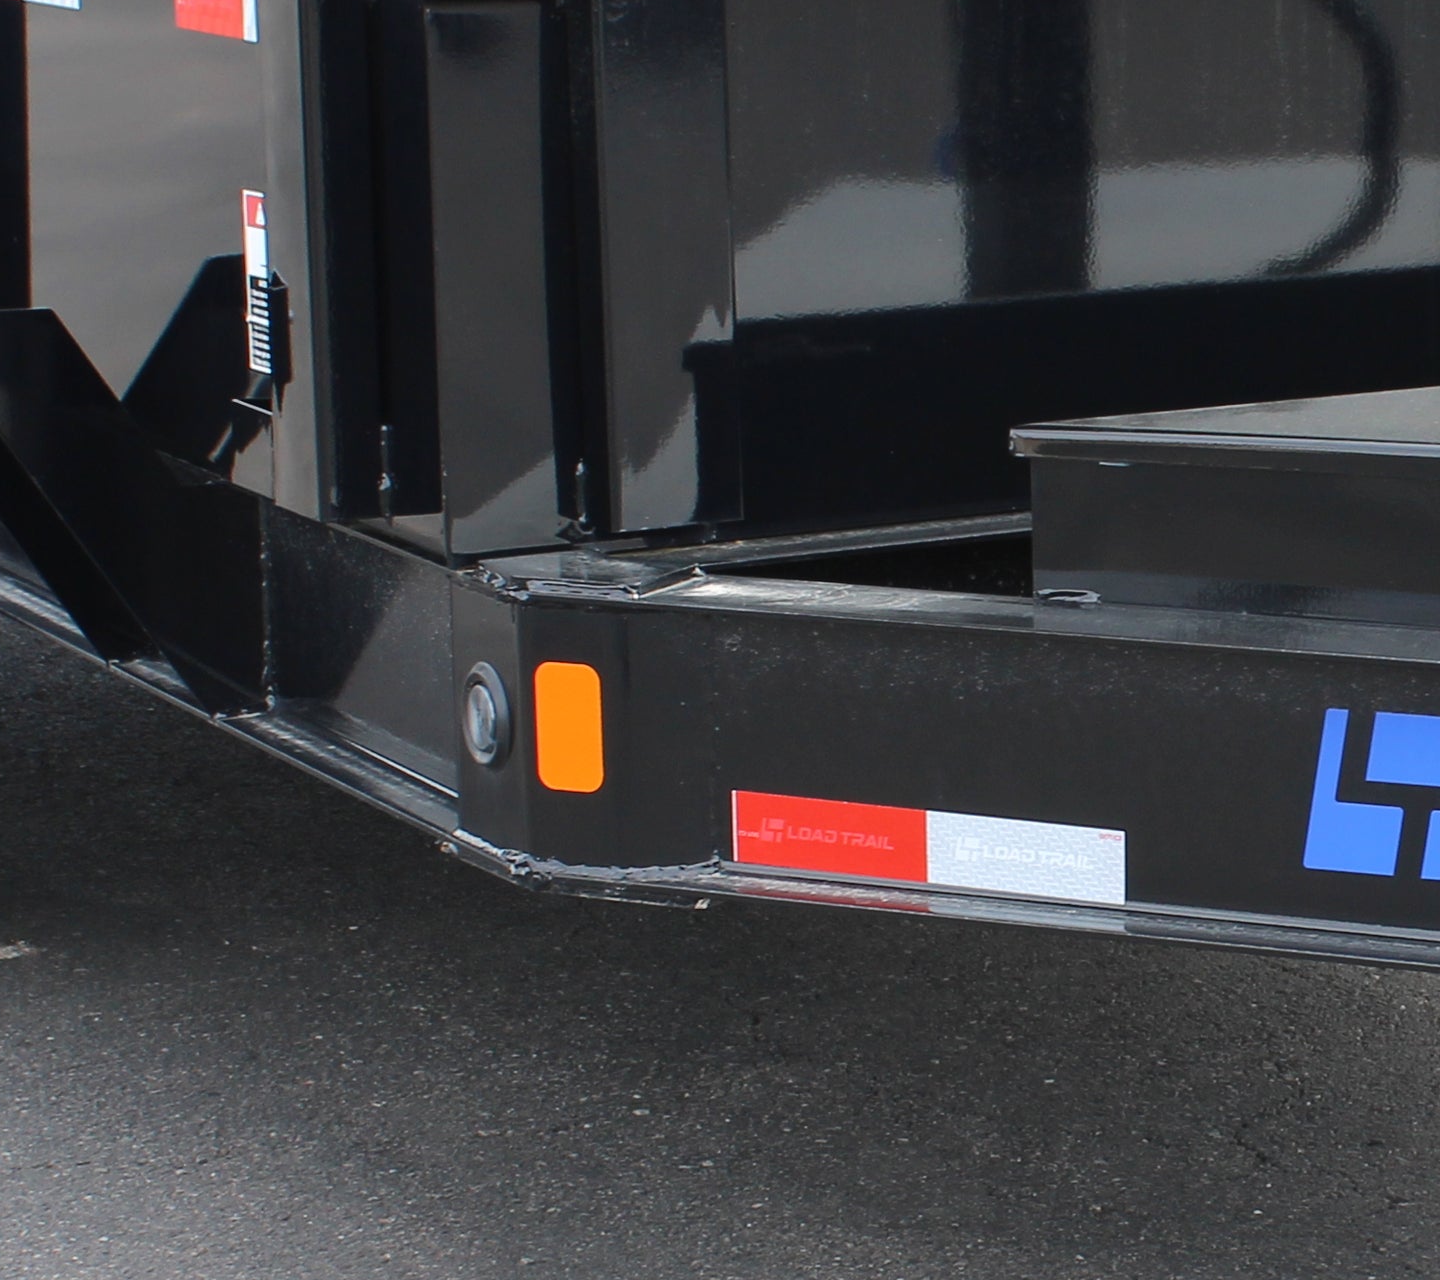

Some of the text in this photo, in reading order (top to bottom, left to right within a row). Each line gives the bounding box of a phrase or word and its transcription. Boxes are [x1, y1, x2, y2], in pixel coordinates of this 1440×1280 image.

[787, 825, 896, 851] LOAD TRAIL
[982, 844, 1095, 870] LOAD TRAIL
